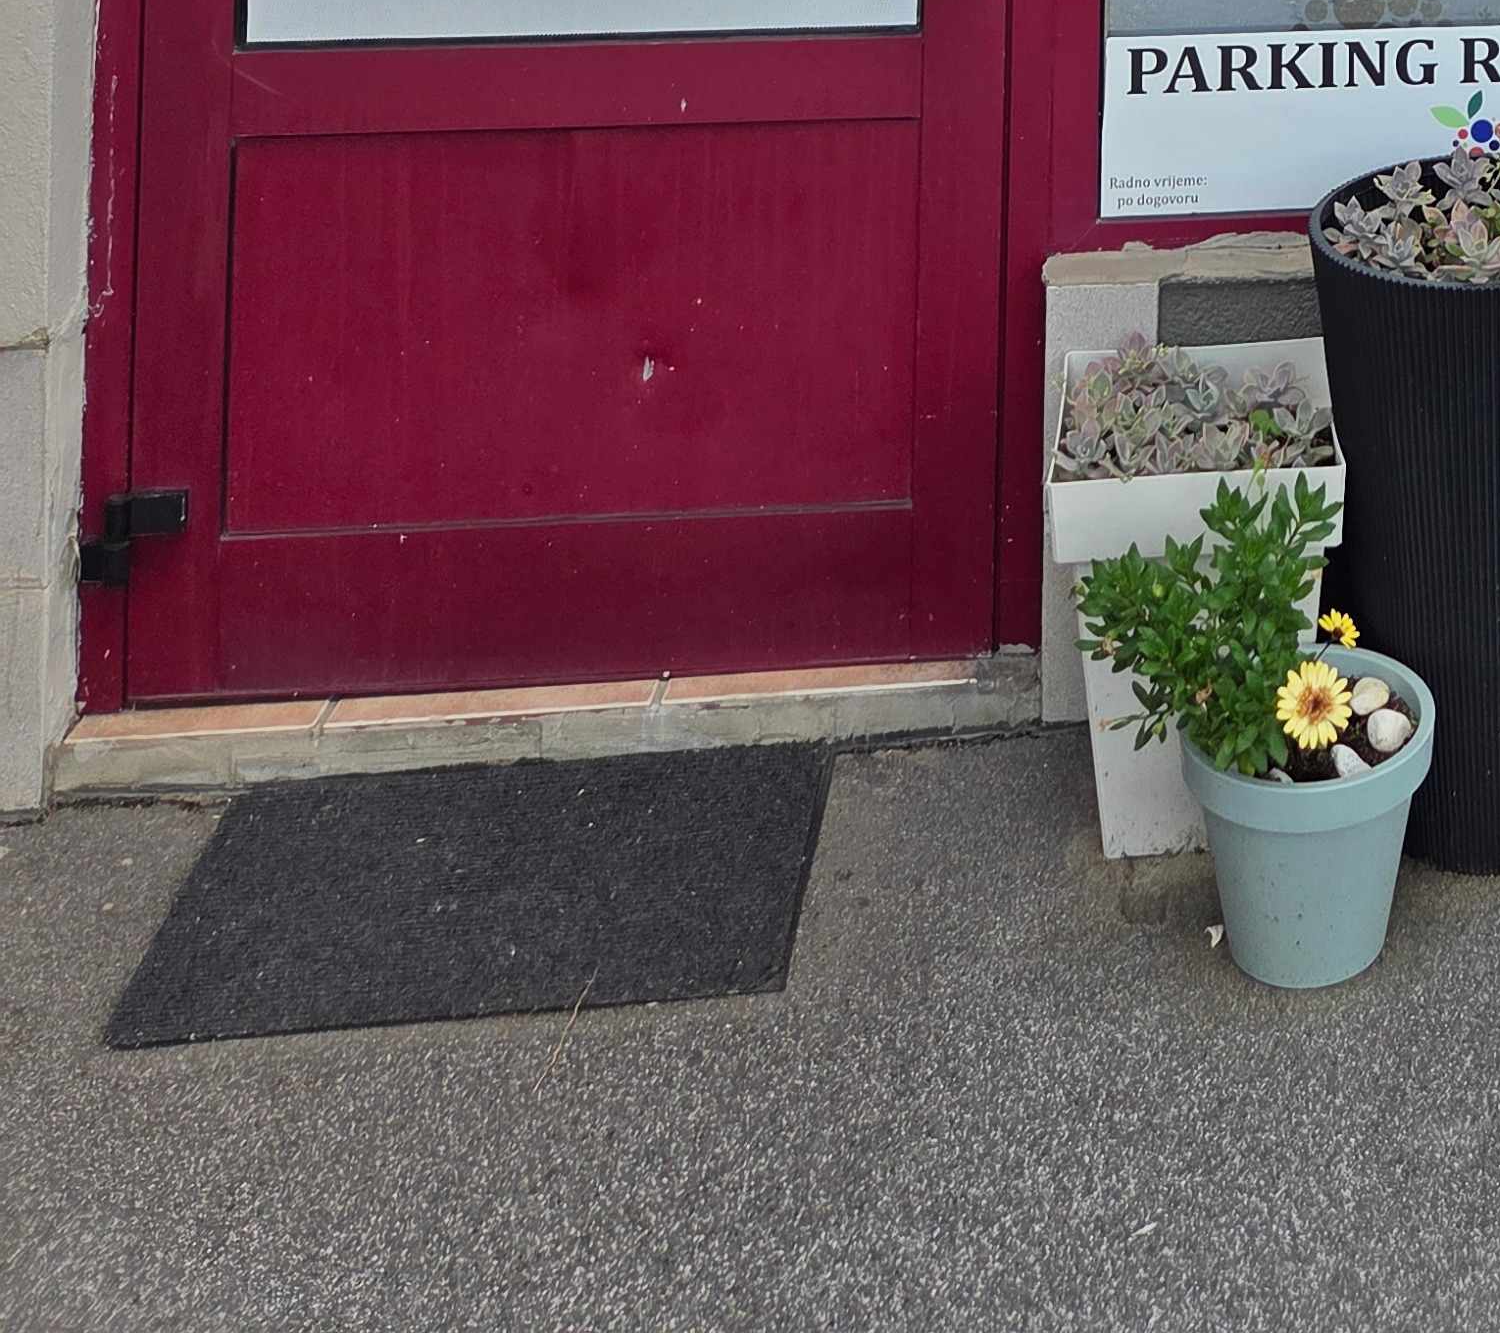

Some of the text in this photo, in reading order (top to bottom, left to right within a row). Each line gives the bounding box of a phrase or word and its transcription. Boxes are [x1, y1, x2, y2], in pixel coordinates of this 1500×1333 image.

[1126, 39, 1439, 95] PARKING
[1109, 175, 1208, 190] Radno vrijeme:
[1117, 193, 1199, 210] po dogovoru
